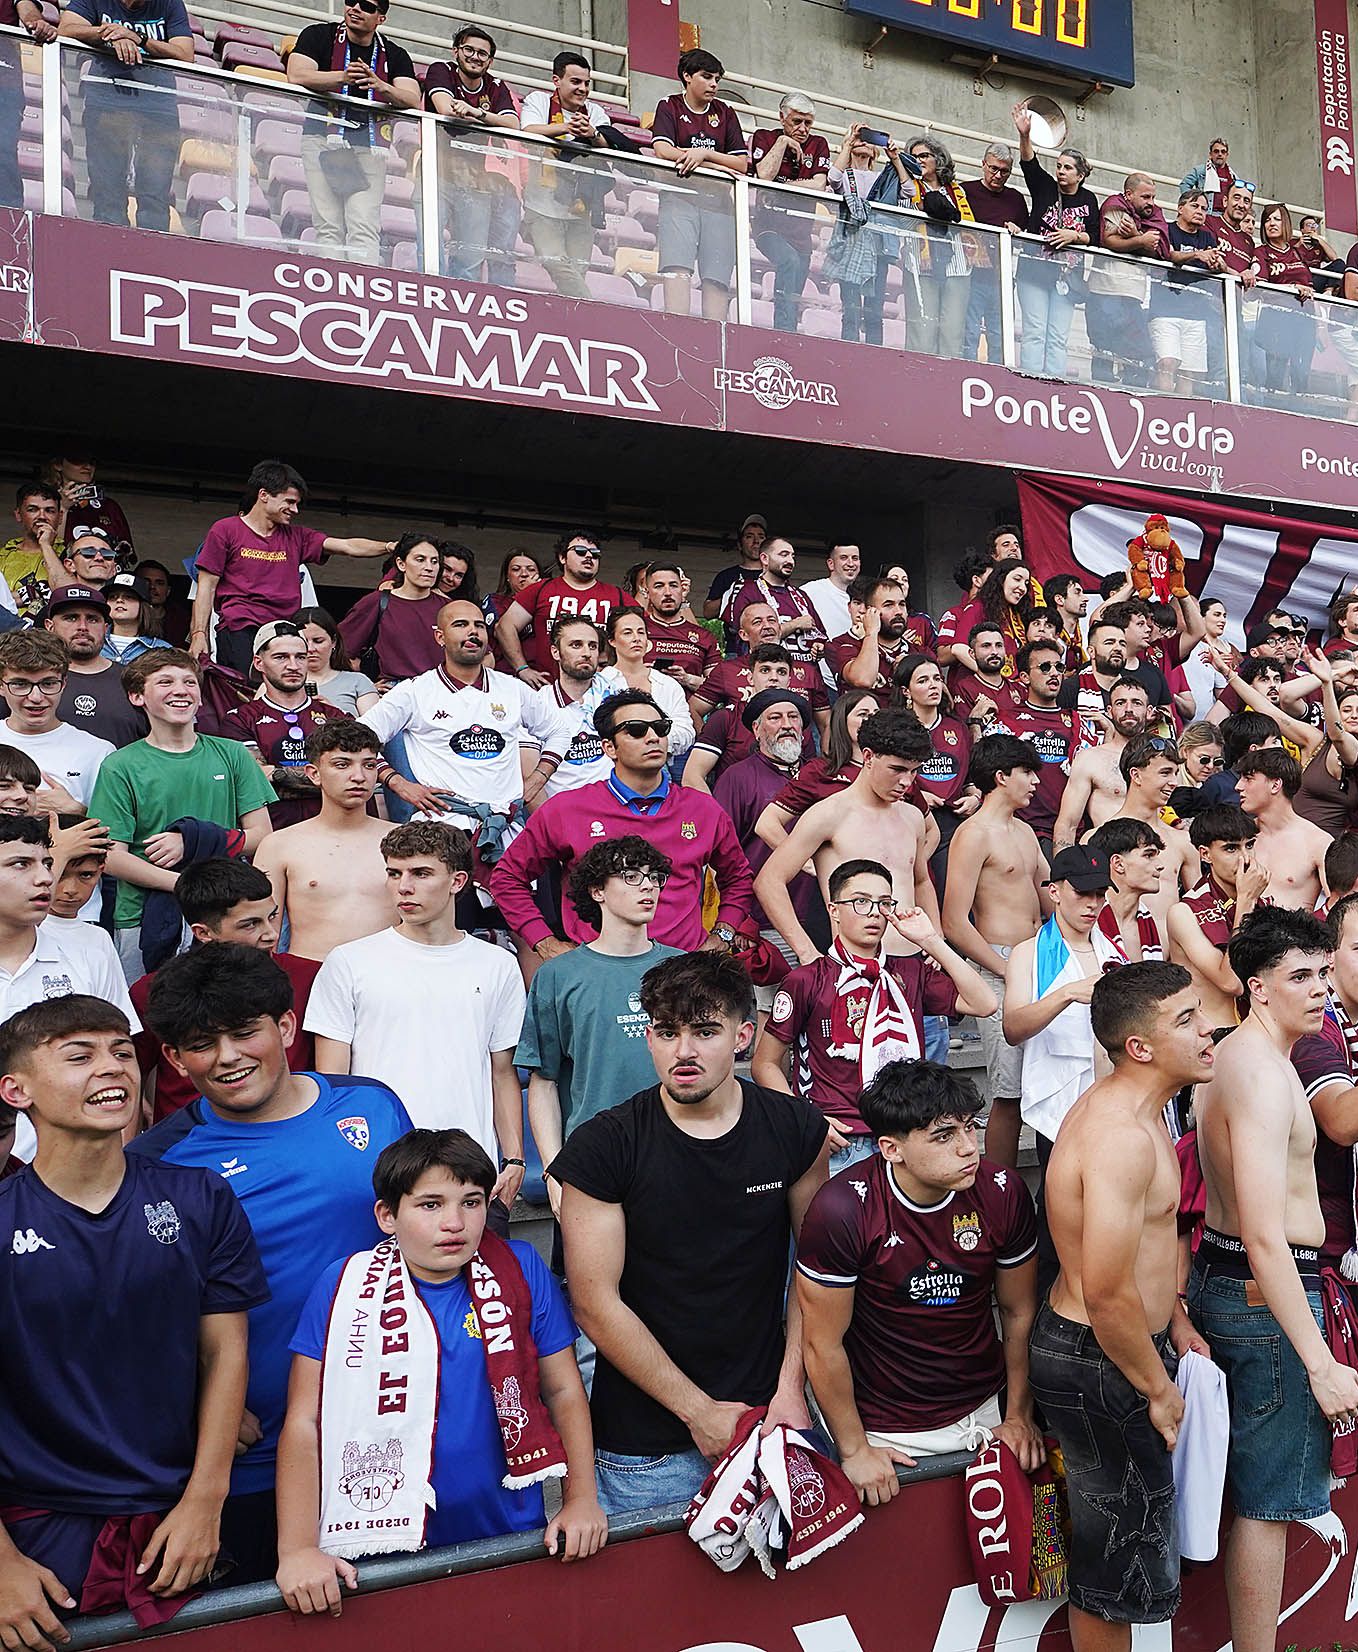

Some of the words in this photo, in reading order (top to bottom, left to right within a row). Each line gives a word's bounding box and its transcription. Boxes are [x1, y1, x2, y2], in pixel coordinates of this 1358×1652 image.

[1322, 30, 1336, 127] Deputación
[1335, 34, 1350, 131] Pontevedra
[273, 262, 529, 322] CONSERVAS
[110, 269, 661, 412] PESCAMAR
[713, 367, 840, 406] PESCAMAR
[548, 595, 611, 623] 1941
[457, 734, 498, 744] Estrella
[460, 741, 498, 751] Galicia
[1034, 735, 1066, 747] Estrella
[569, 748, 603, 760] Galicia
[922, 765, 952, 775] Galicia
[746, 1181, 783, 1194] MCKENZIE
[909, 1273, 964, 1292] Estrella
[517, 1447, 549, 1464] 1941
[825, 1503, 848, 1527] 1941
